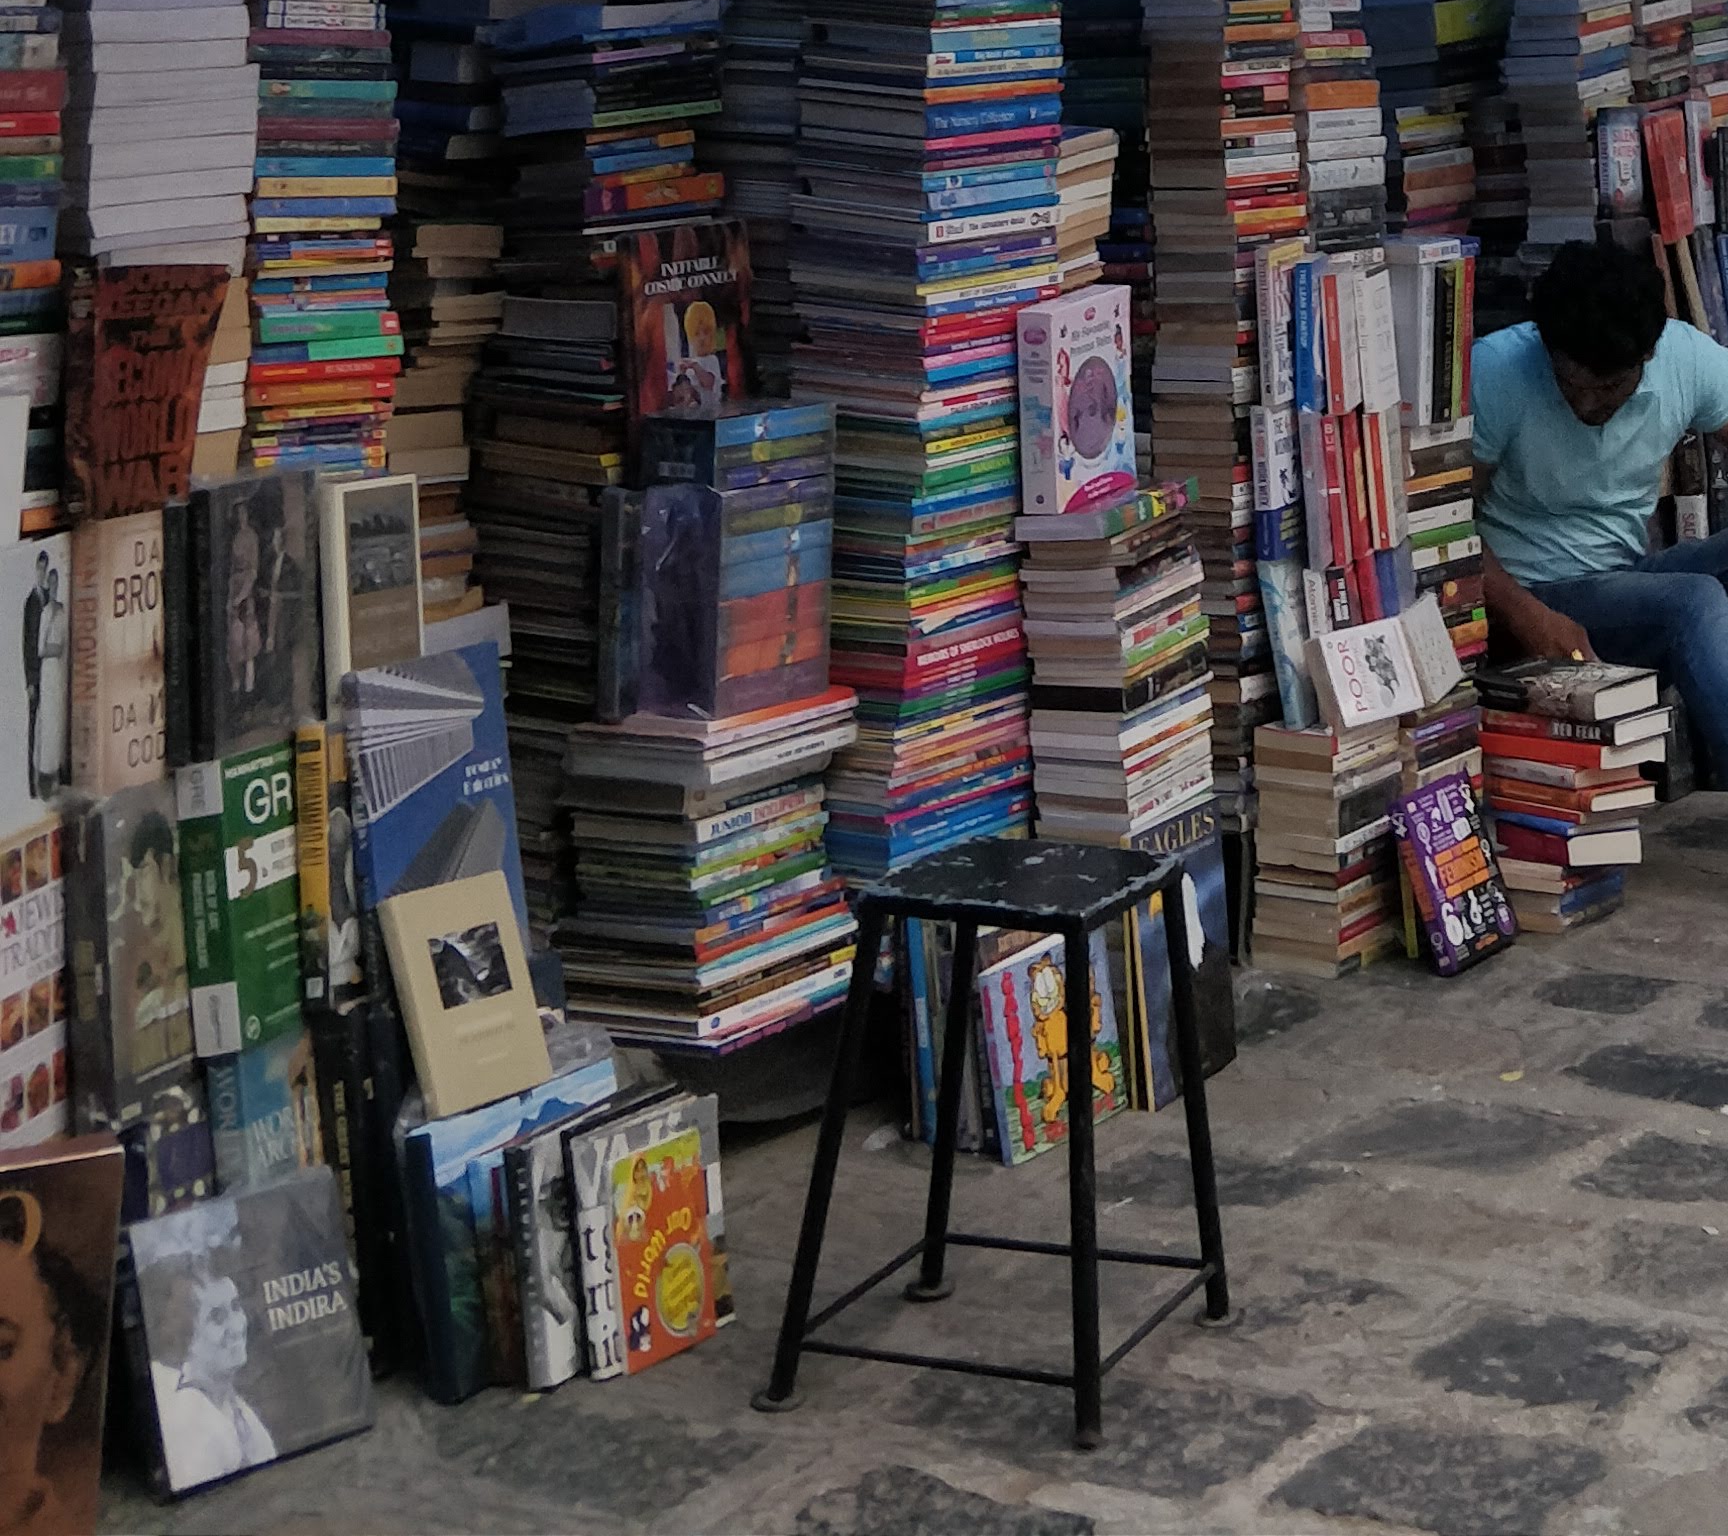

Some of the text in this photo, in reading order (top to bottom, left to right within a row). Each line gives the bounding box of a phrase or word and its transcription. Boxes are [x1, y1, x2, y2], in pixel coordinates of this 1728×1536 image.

[135, 540, 163, 568] DA
[113, 572, 159, 619] BRO
[76, 597, 99, 703] BROWN
[949, 644, 960, 658] OF
[960, 635, 993, 655] SHERLOCK
[994, 627, 1020, 644] HOLMES
[1337, 638, 1367, 713] POOR
[127, 730, 165, 768] COD
[244, 771, 294, 825] GR
[711, 811, 752, 836] JUNIOR
[1137, 806, 1217, 855] EAGLES
[263, 1261, 343, 1305] INDIA'S
[267, 1290, 348, 1330] INDIRA
